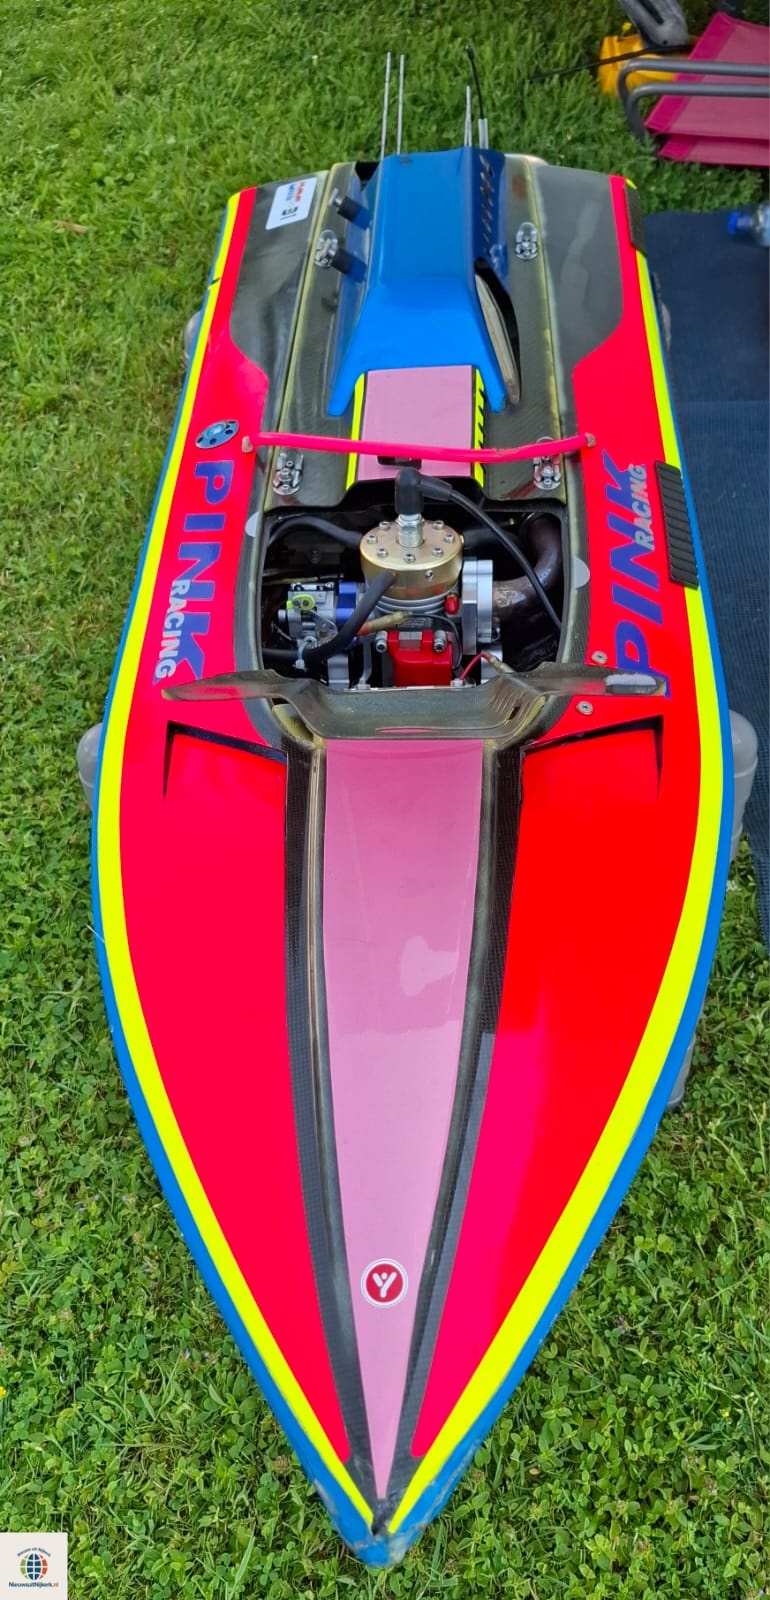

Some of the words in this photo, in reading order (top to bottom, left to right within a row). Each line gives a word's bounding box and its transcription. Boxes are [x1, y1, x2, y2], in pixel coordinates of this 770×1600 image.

[153, 460, 235, 685] PINK
[602, 448, 672, 701] PINK
[628, 463, 655, 551] RACING
[154, 579, 191, 679] RACING
